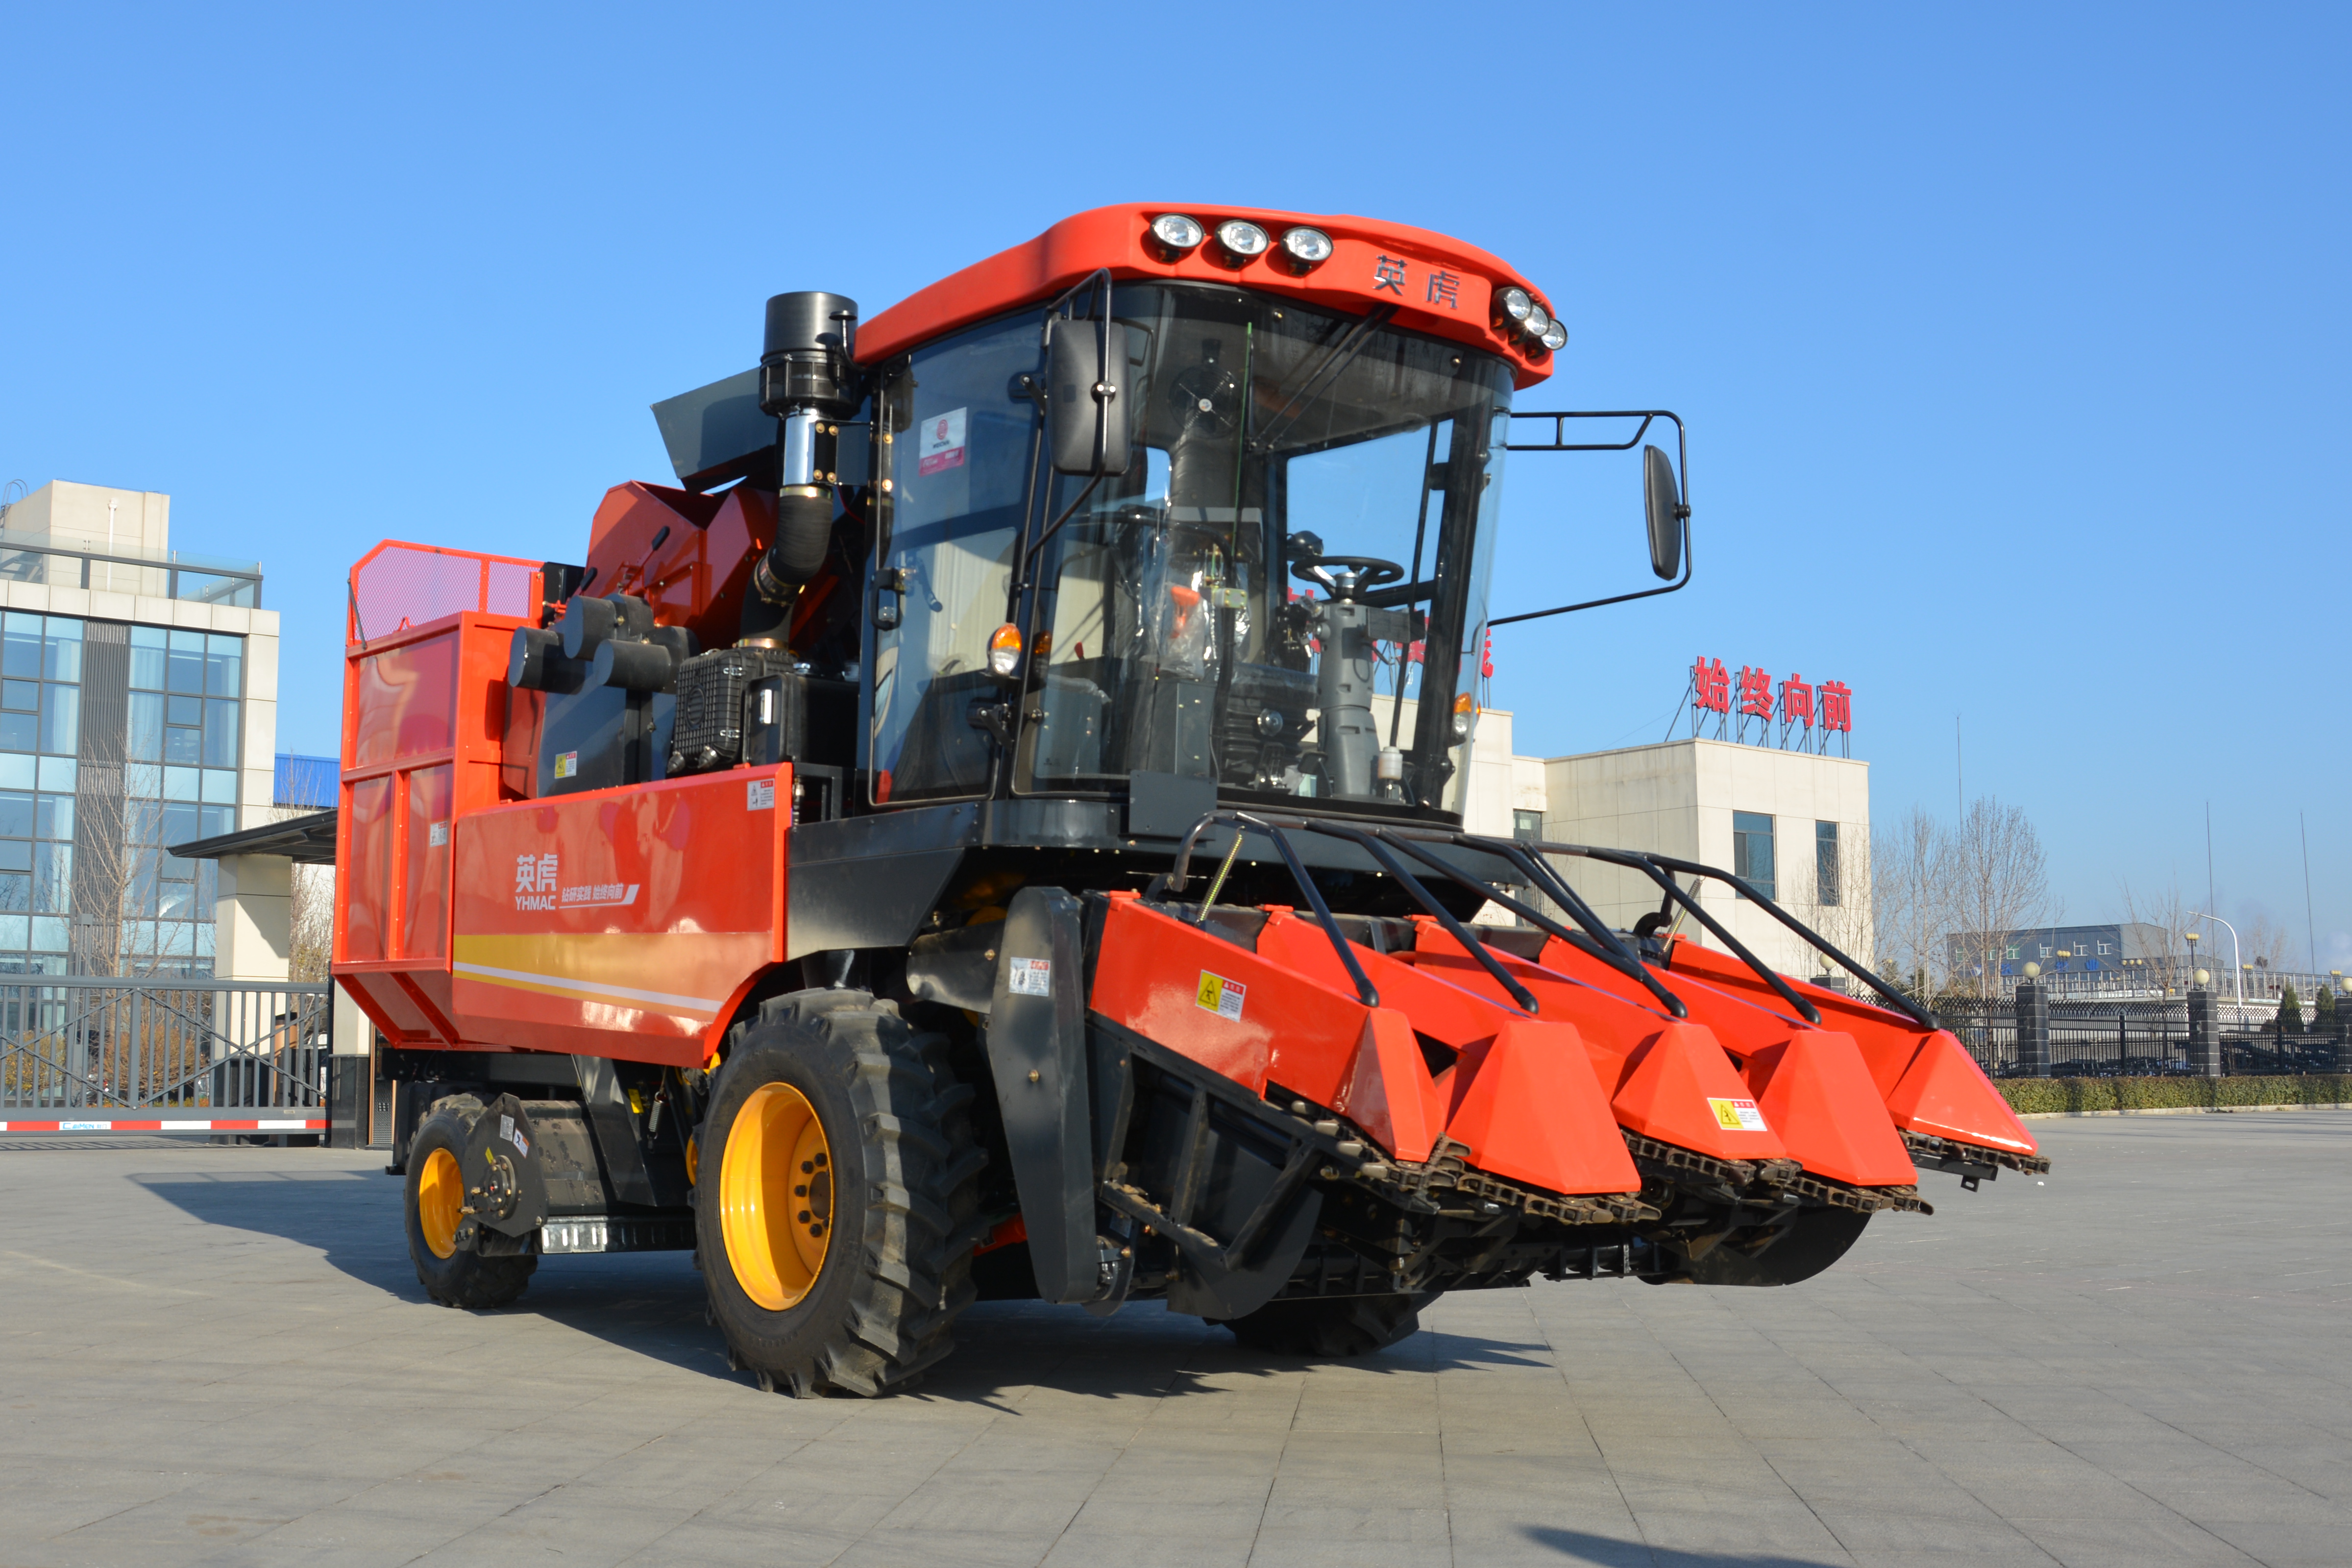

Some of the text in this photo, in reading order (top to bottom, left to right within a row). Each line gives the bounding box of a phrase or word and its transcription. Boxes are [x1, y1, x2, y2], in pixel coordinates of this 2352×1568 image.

[1372, 254, 1459, 309] 英虎
[1694, 655, 1852, 733] 始终向前
[515, 854, 558, 892] 英虎
[592, 883, 624, 900] 始终向前
[515, 895, 557, 910] YHMAC
